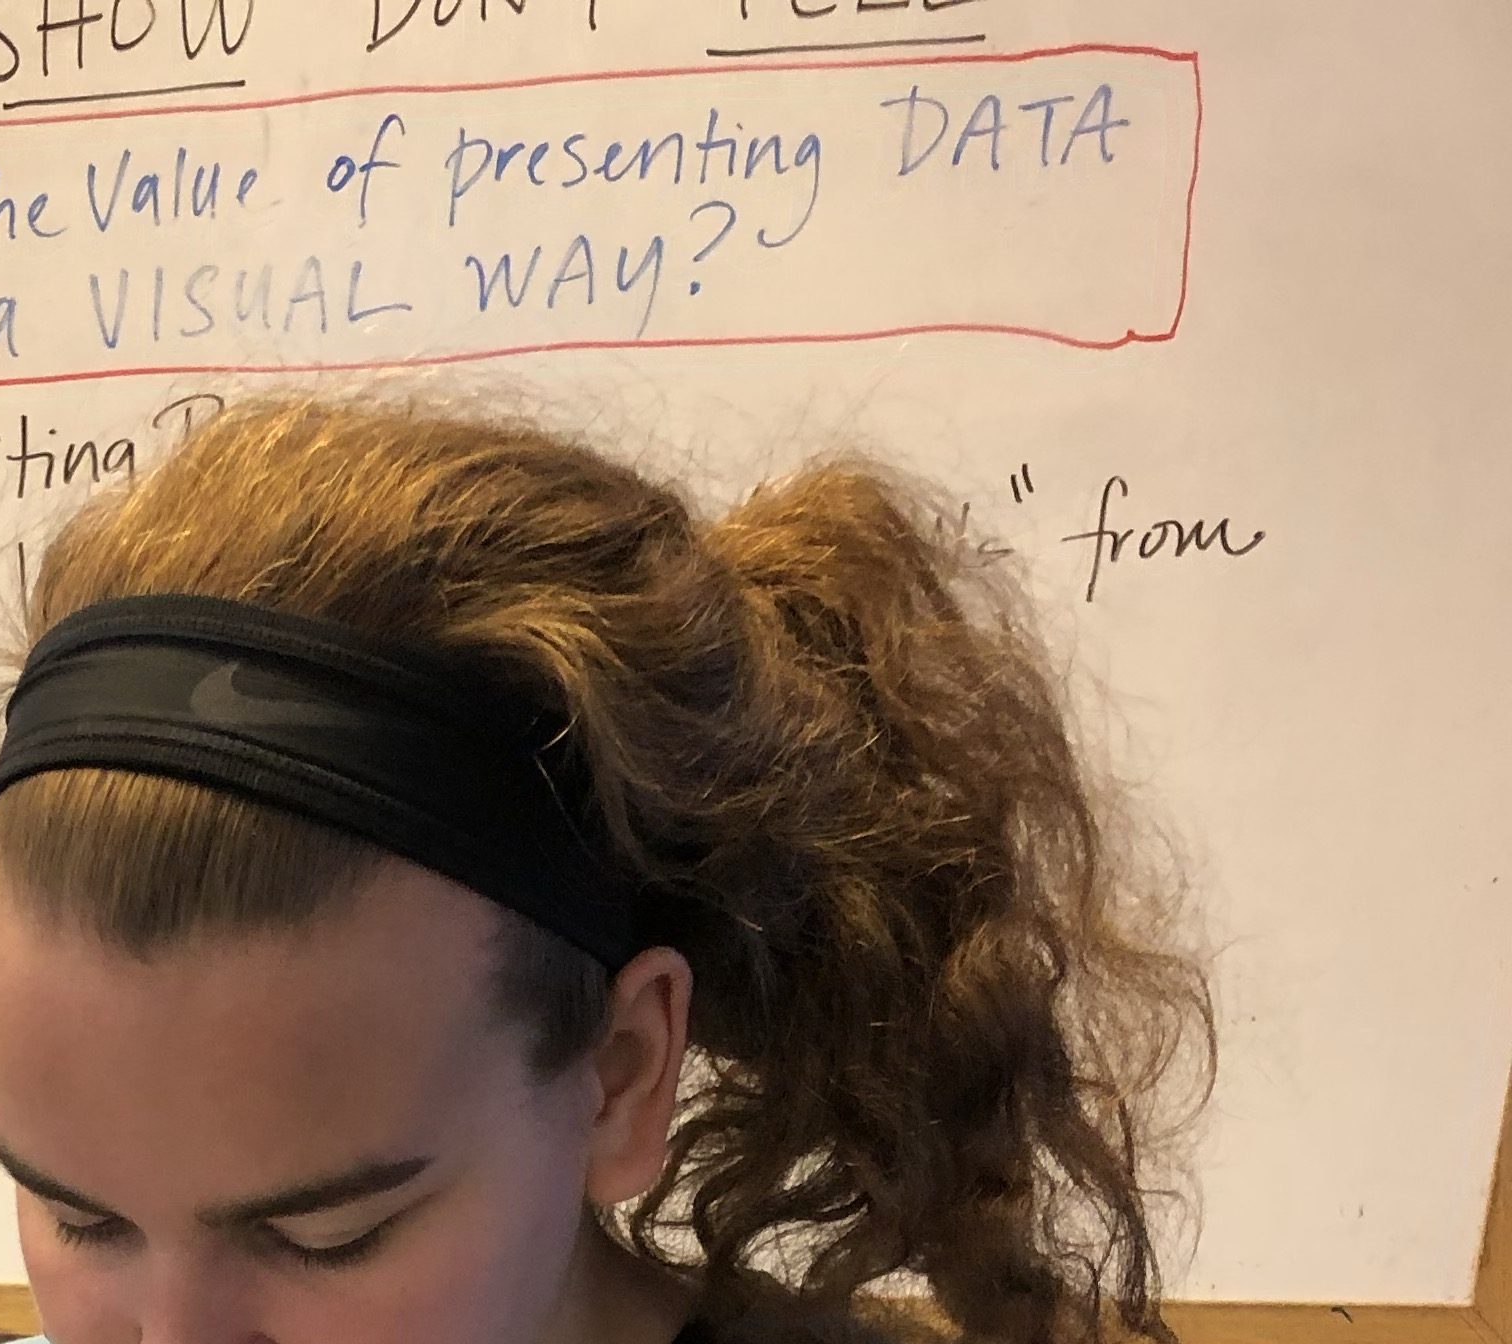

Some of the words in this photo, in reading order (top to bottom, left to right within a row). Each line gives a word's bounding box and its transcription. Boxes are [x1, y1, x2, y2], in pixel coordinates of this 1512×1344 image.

[326, 113, 409, 228] of
[444, 108, 824, 249] presenting
[881, 82, 1131, 179] DATA
[88, 259, 415, 351] VISUAL
[464, 199, 738, 339] WAY?
[1060, 474, 1268, 604] from
